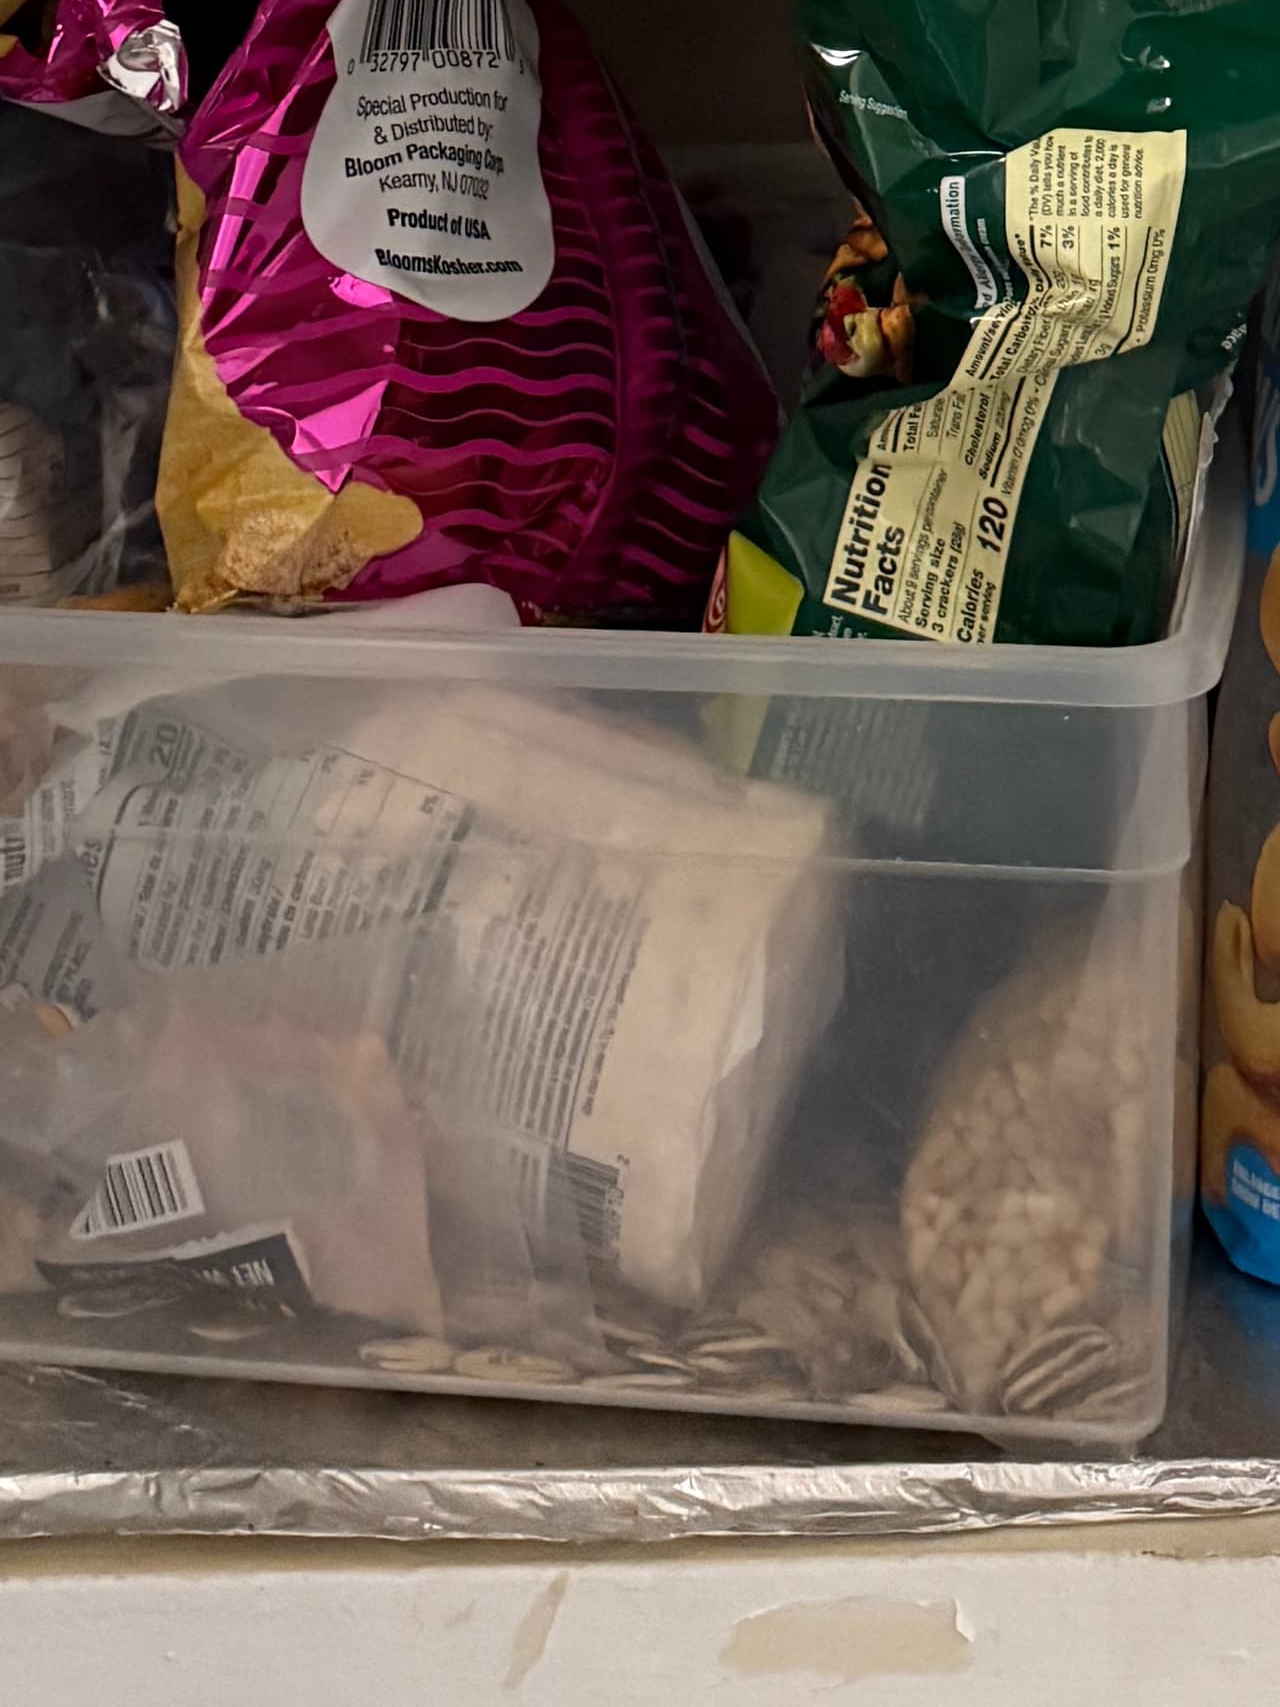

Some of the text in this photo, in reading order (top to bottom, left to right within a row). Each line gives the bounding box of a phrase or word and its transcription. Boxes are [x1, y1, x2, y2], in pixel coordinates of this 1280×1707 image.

[370, 49, 500, 73] 32797 00872
[357, 87, 508, 120] Special Production for
[374, 125, 388, 145] &
[391, 114, 475, 142] Distributed
[345, 151, 403, 178] Bloom
[406, 142, 482, 171] Packaging
[380, 172, 439, 194] Kearny,
[442, 170, 458, 195] NJ
[387, 207, 493, 241] Product of USA
[375, 248, 524, 276] BloomsKosher.com
[831, 462, 906, 616] Nutrition Facts
[915, 537, 947, 628] Serving size
[957, 496, 1009, 644] Calories 120
[931, 553, 960, 633] 3 crackers
